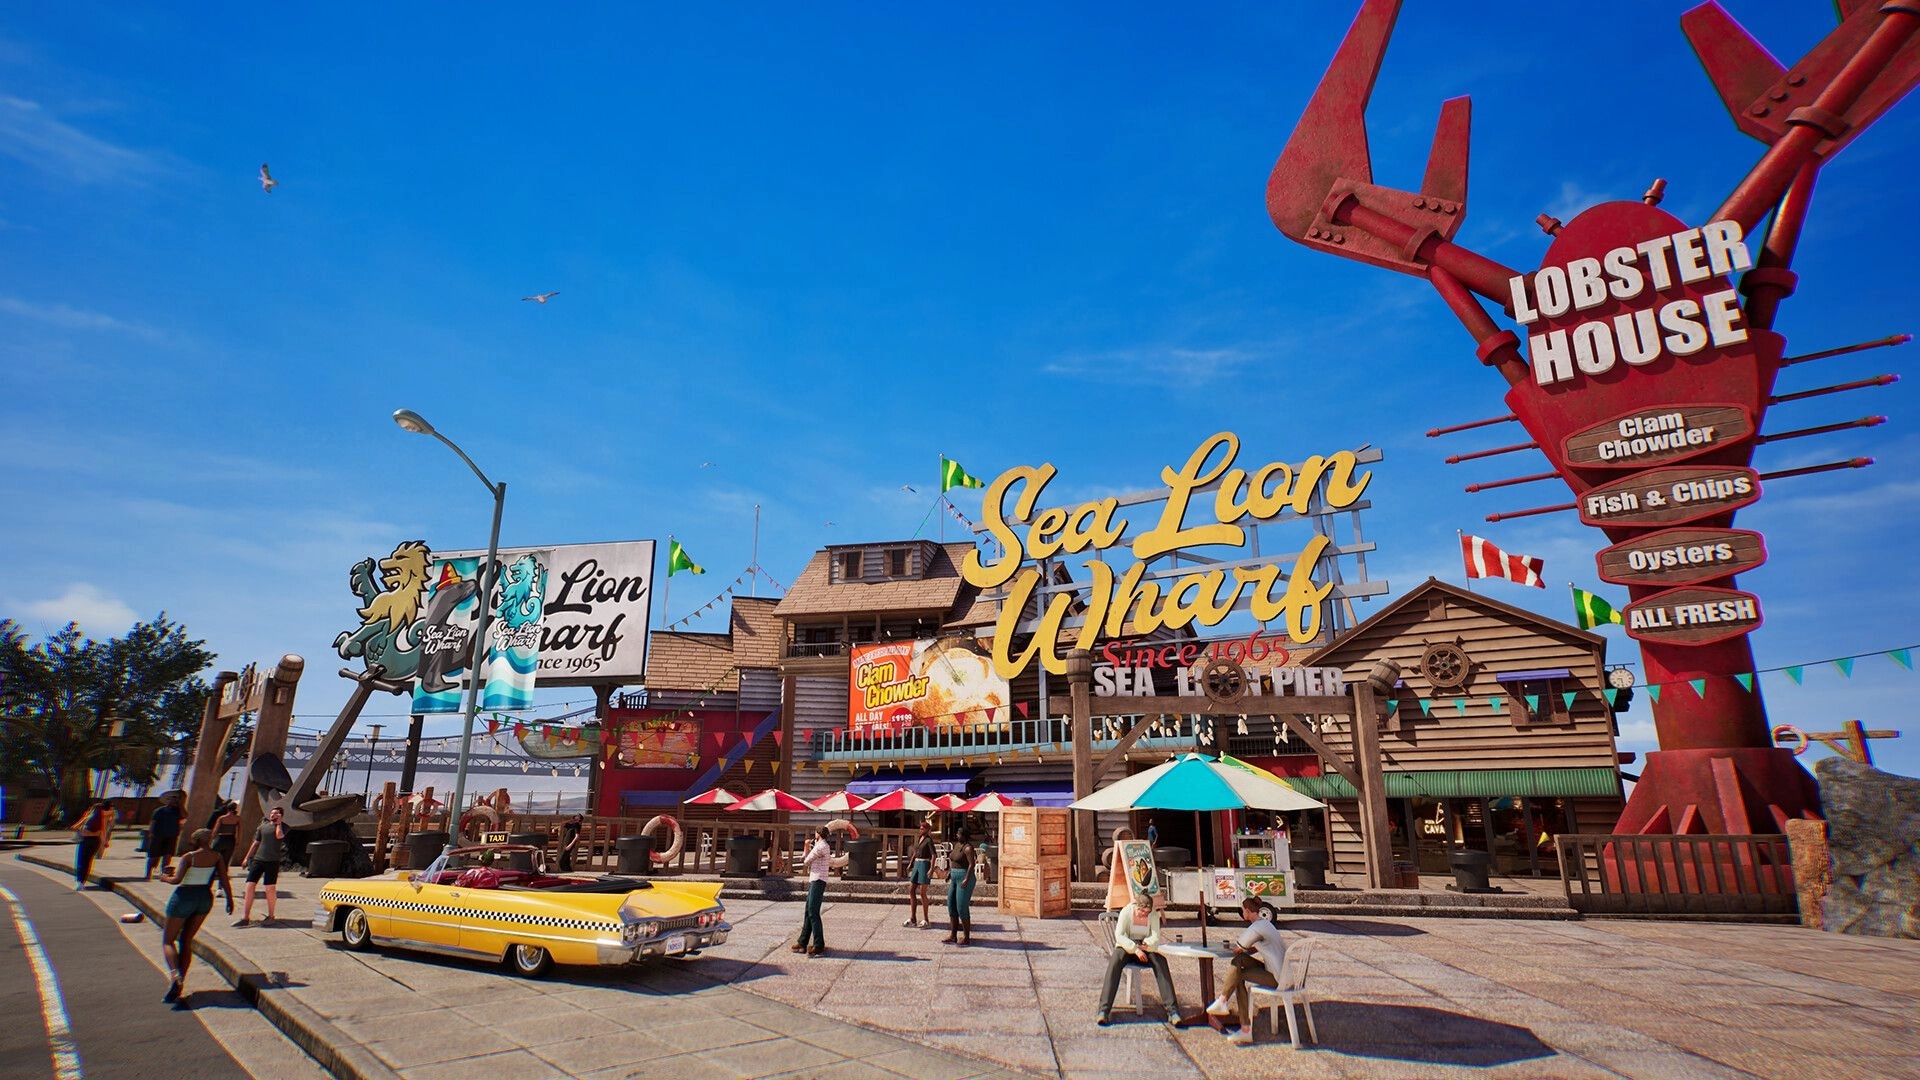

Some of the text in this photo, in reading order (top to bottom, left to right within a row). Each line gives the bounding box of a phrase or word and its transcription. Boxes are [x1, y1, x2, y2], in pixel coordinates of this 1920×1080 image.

[1509, 220, 1751, 325] LOBSTER
[1529, 289, 1748, 386] HOUSE
[1619, 412, 1685, 437] Clam
[1598, 425, 1715, 460] Chowder
[962, 431, 1372, 588] Sea Lion
[1587, 477, 1752, 515] Fish & Chips
[1628, 543, 1733, 571] Oysters
[544, 558, 648, 614] Lion
[996, 534, 1334, 680] Wharf
[1631, 600, 1757, 629] ALL FRESH
[423, 624, 468, 642] Sea Lion
[493, 620, 543, 639] Sea Lion
[495, 633, 538, 651] Wharf
[425, 639, 462, 654] Wharf
[1102, 629, 1290, 669] Since 1965
[565, 656, 601, 673] 1965
[857, 662, 895, 689] Clam
[865, 675, 929, 709] Chowder
[1094, 667, 1347, 697] SEA LIN PIER
[855, 711, 883, 722] ALL DAY
